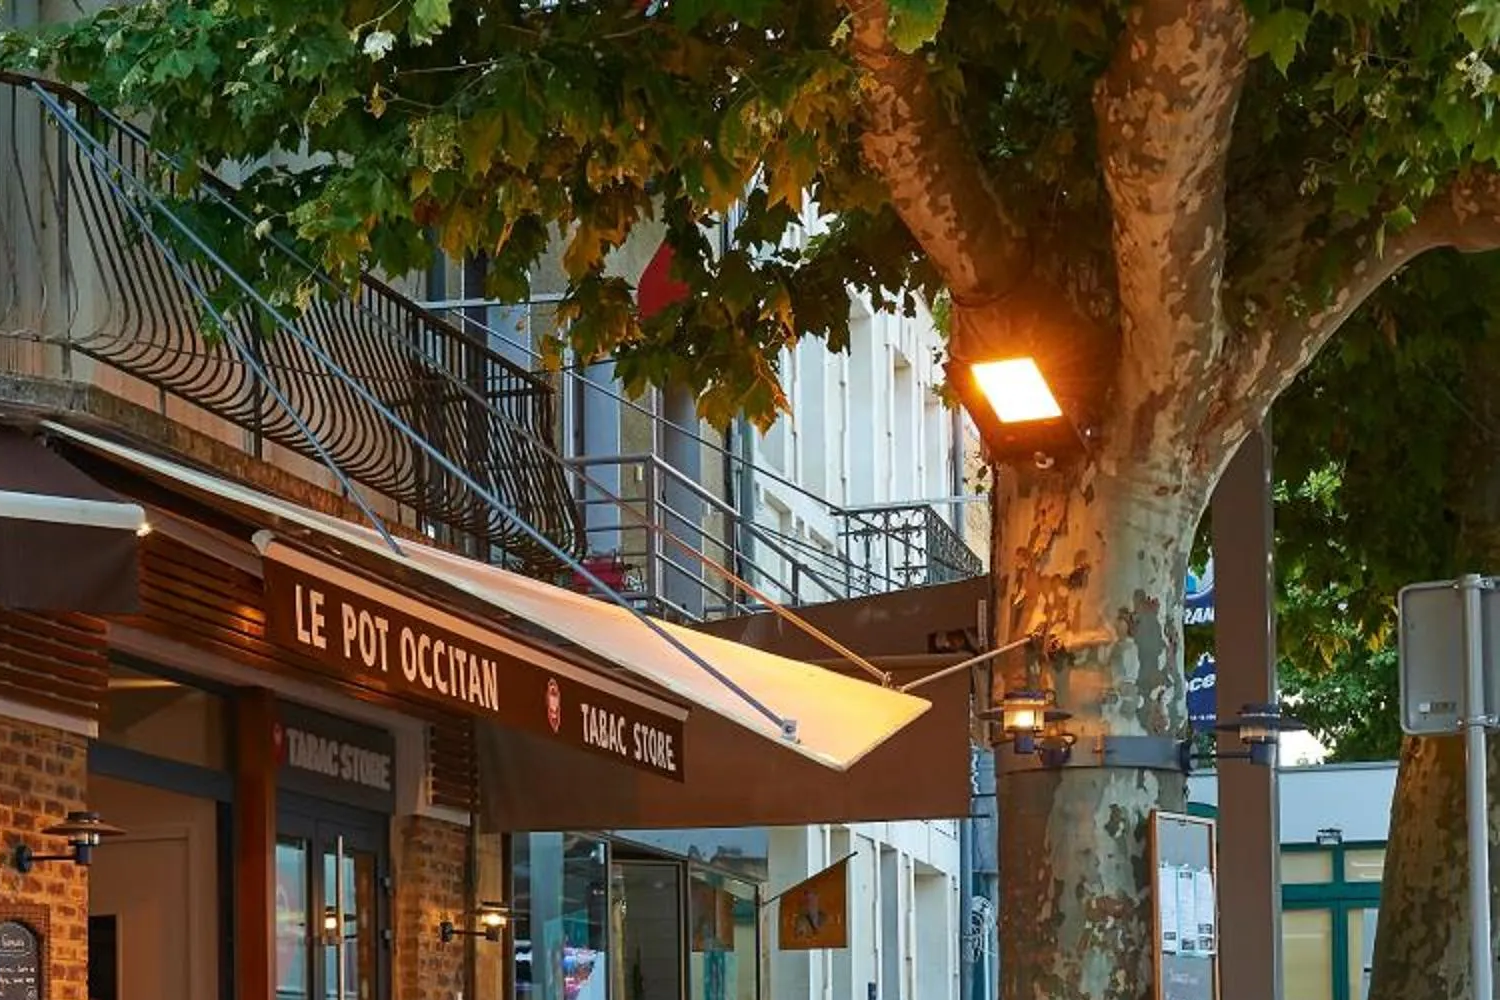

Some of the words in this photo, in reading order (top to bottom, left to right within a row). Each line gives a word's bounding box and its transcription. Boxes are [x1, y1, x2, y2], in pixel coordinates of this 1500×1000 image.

[295, 584, 327, 649] LE
[341, 602, 389, 673] POT
[400, 626, 499, 712] OCCITAN
[580, 703, 627, 756] TABAC
[633, 722, 676, 772] STORE
[287, 728, 339, 777] TABAC
[340, 743, 392, 791] STORE
